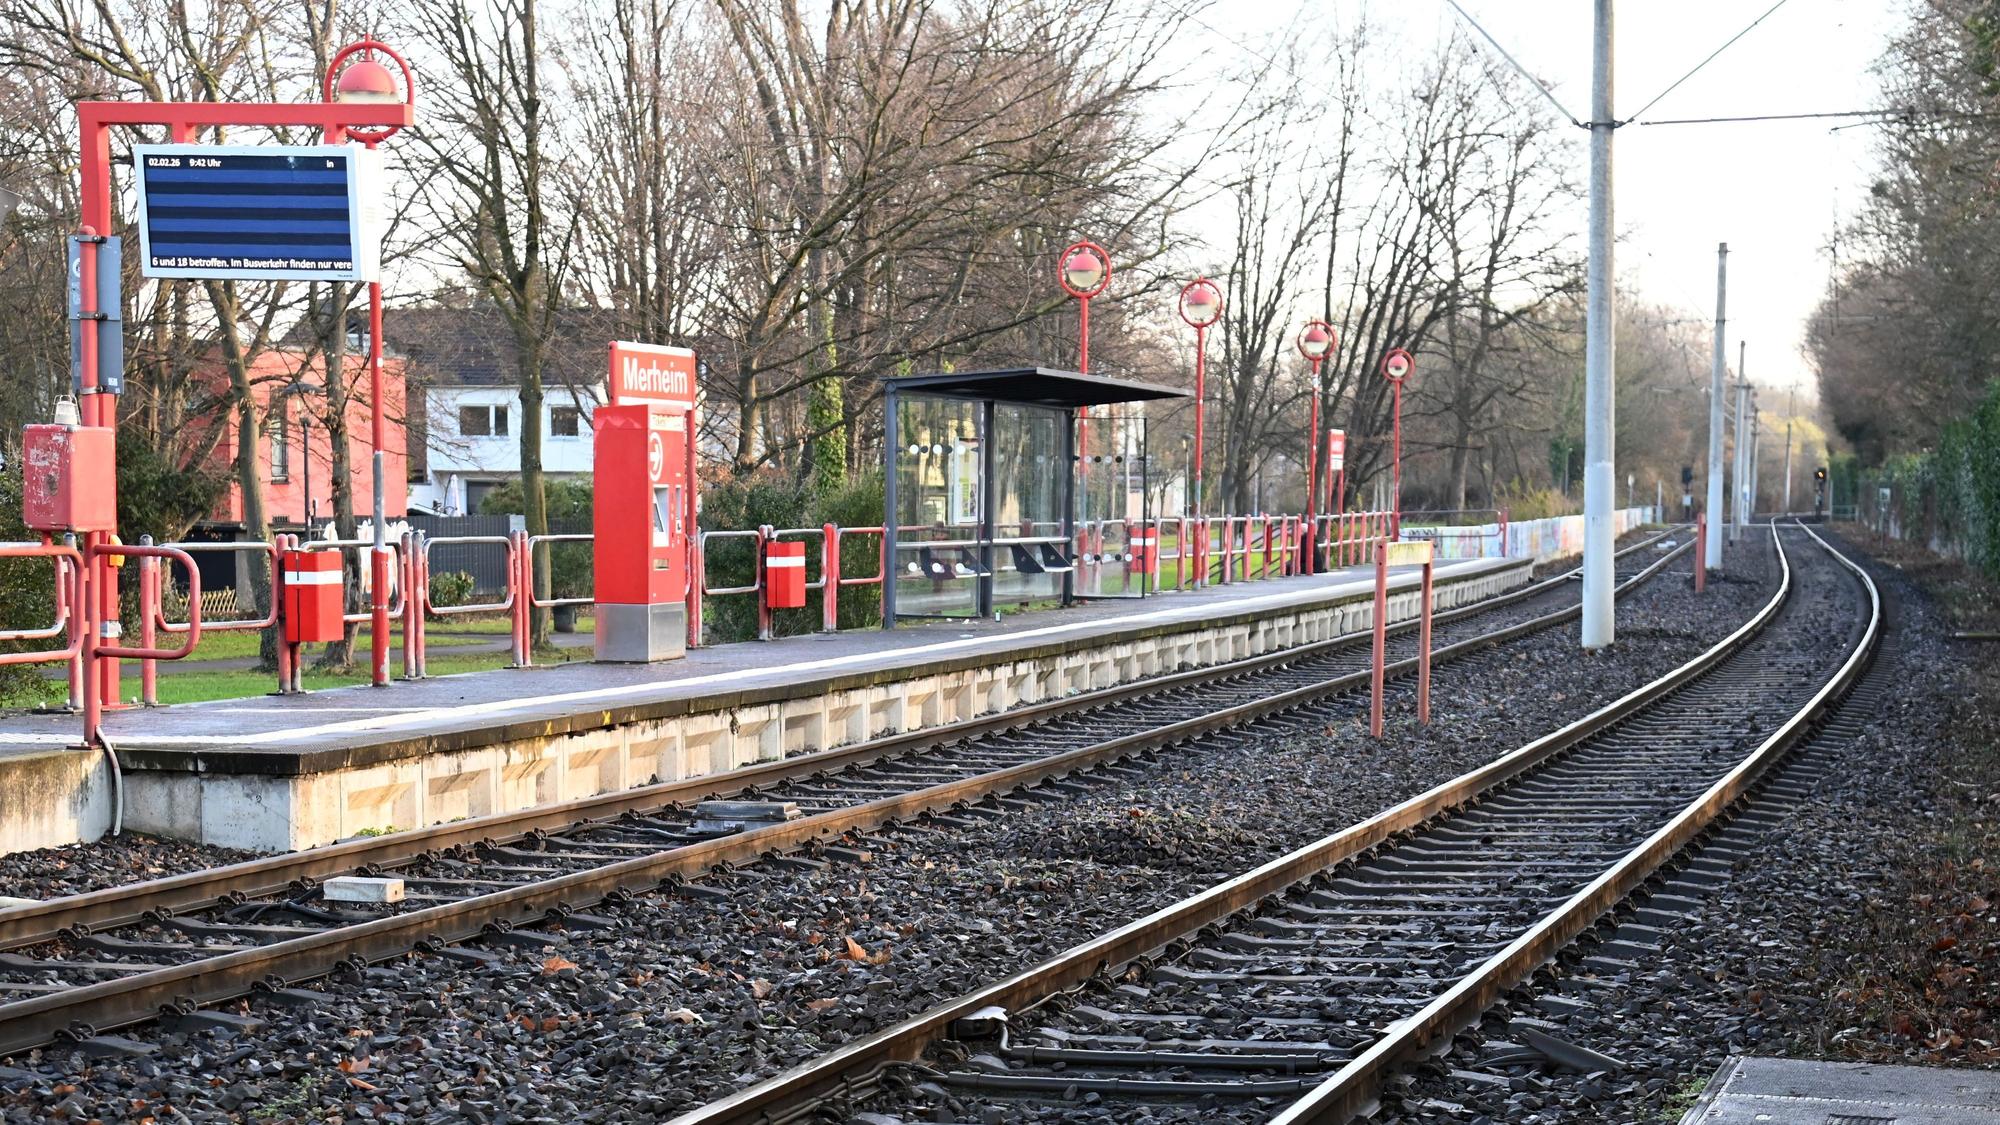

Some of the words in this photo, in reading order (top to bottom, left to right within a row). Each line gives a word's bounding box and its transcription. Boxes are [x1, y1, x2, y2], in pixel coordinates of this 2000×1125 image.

[148, 158, 181, 167] 02.02.26
[189, 158, 206, 167] 9:42
[207, 158, 222, 167] Uhr
[152, 257, 159, 266] 6
[160, 257, 176, 267] und
[177, 258, 188, 267] 18
[189, 257, 230, 268] betroffen.
[231, 258, 242, 268] Im
[243, 258, 288, 269] Busverkehr
[289, 259, 316, 269] finden
[318, 261, 332, 269] nur
[333, 261, 352, 270] vere
[623, 357, 688, 395] Merheim
